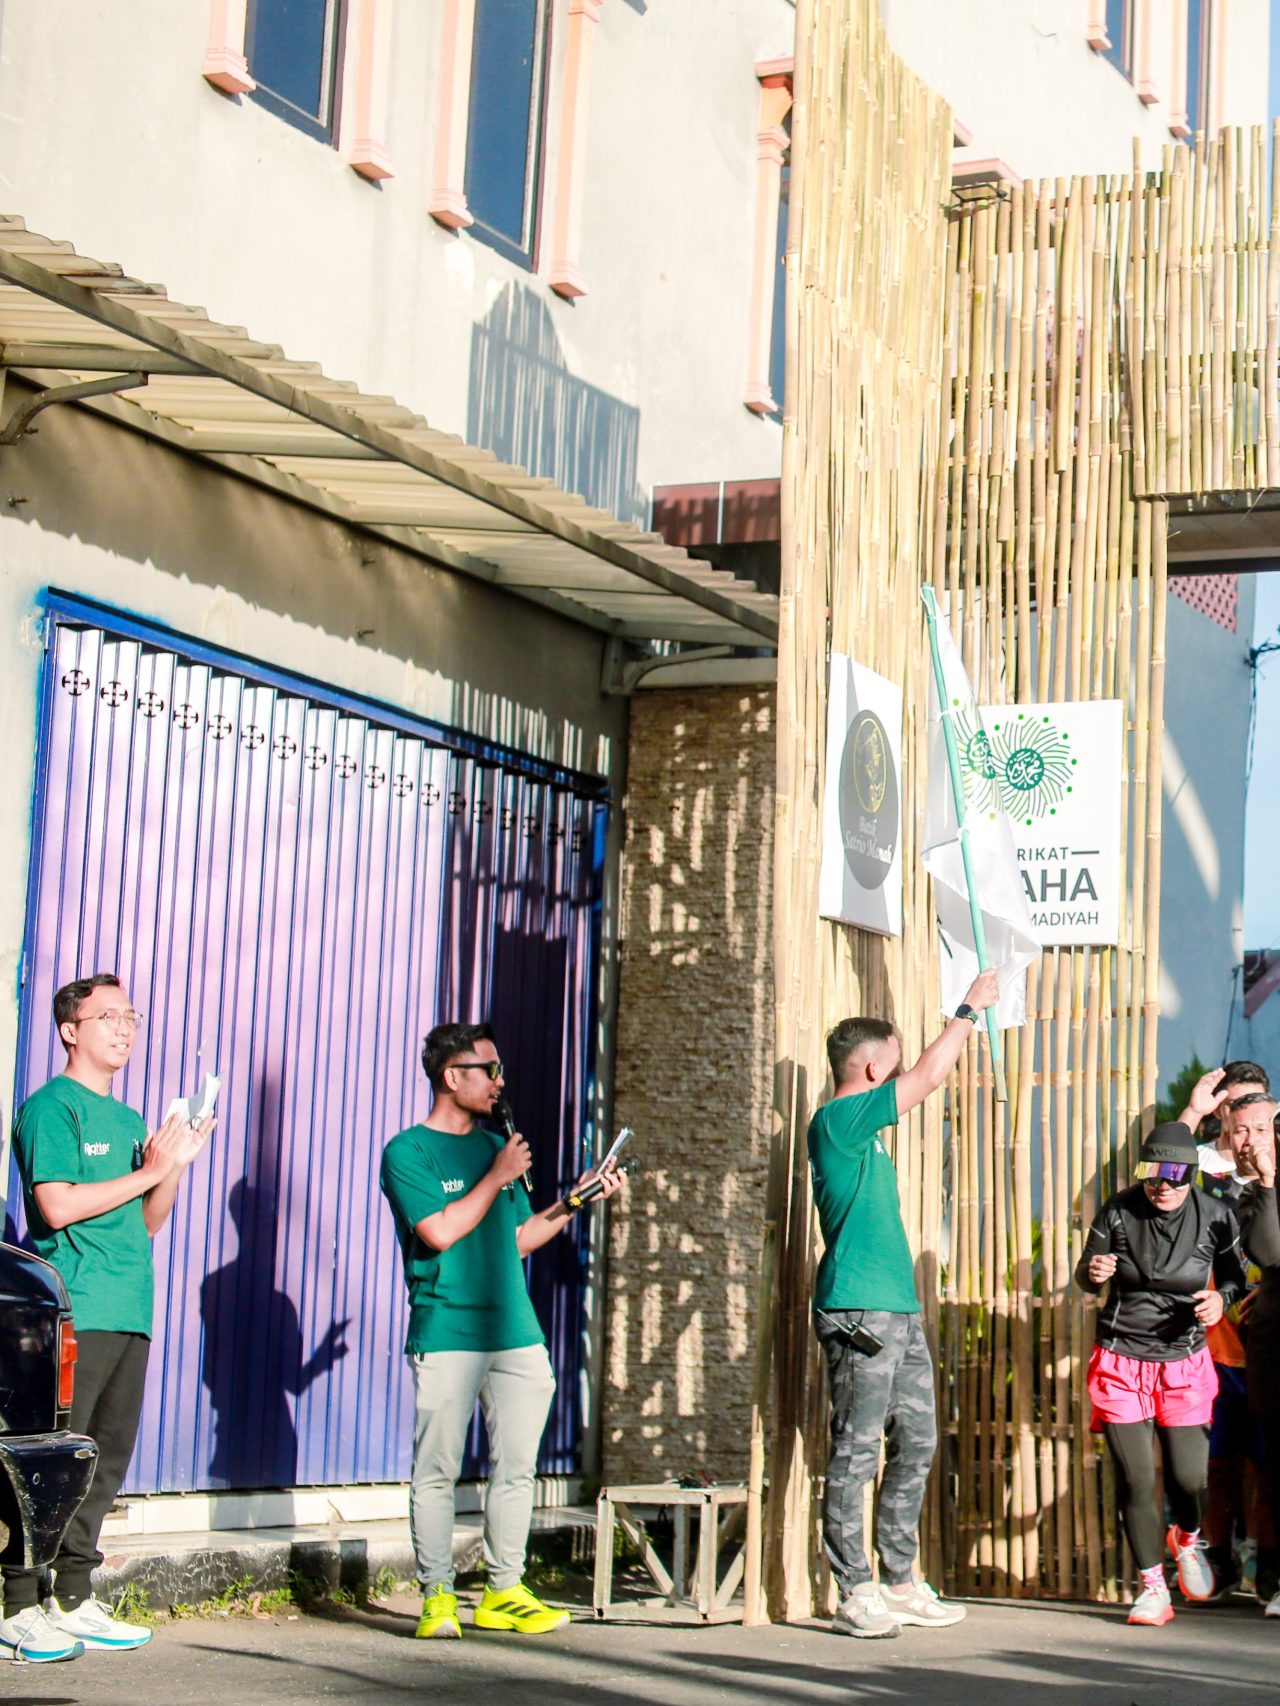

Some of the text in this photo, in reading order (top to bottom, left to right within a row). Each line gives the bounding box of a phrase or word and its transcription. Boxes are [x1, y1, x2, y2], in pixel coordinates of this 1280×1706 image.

[1017, 847, 1069, 861] RIKAT
[1021, 867, 1099, 903] AHA
[1030, 911, 1099, 927] MADIYAH
